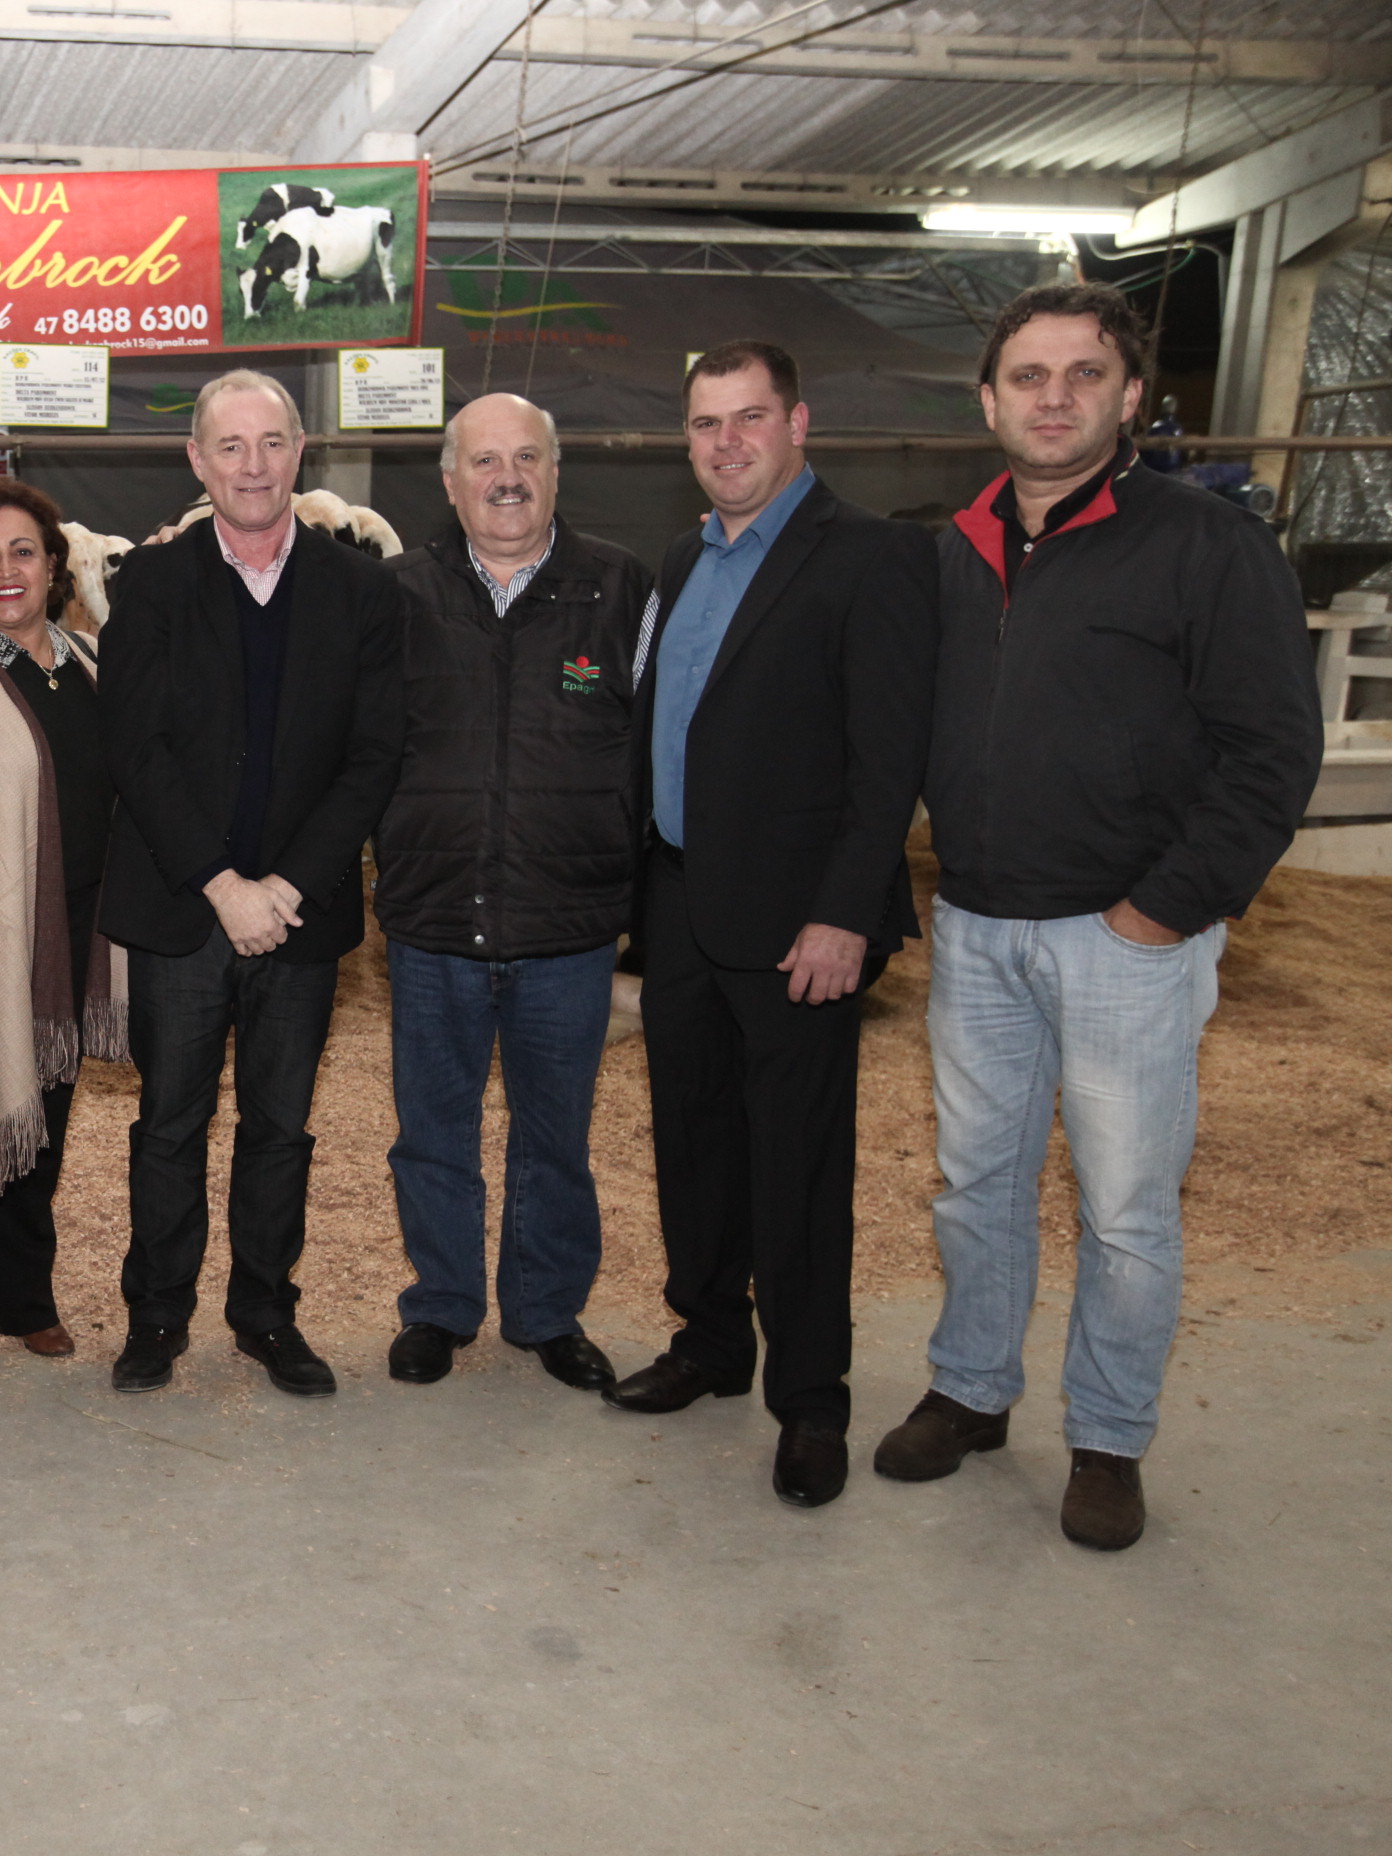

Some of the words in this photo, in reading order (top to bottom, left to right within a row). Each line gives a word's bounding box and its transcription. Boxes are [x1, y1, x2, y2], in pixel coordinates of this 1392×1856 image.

[33, 316, 59, 335] 47
[62, 306, 132, 335] 8488
[139, 304, 209, 332] 6300
[83, 361, 99, 373] 114
[422, 362, 436, 374] 101
